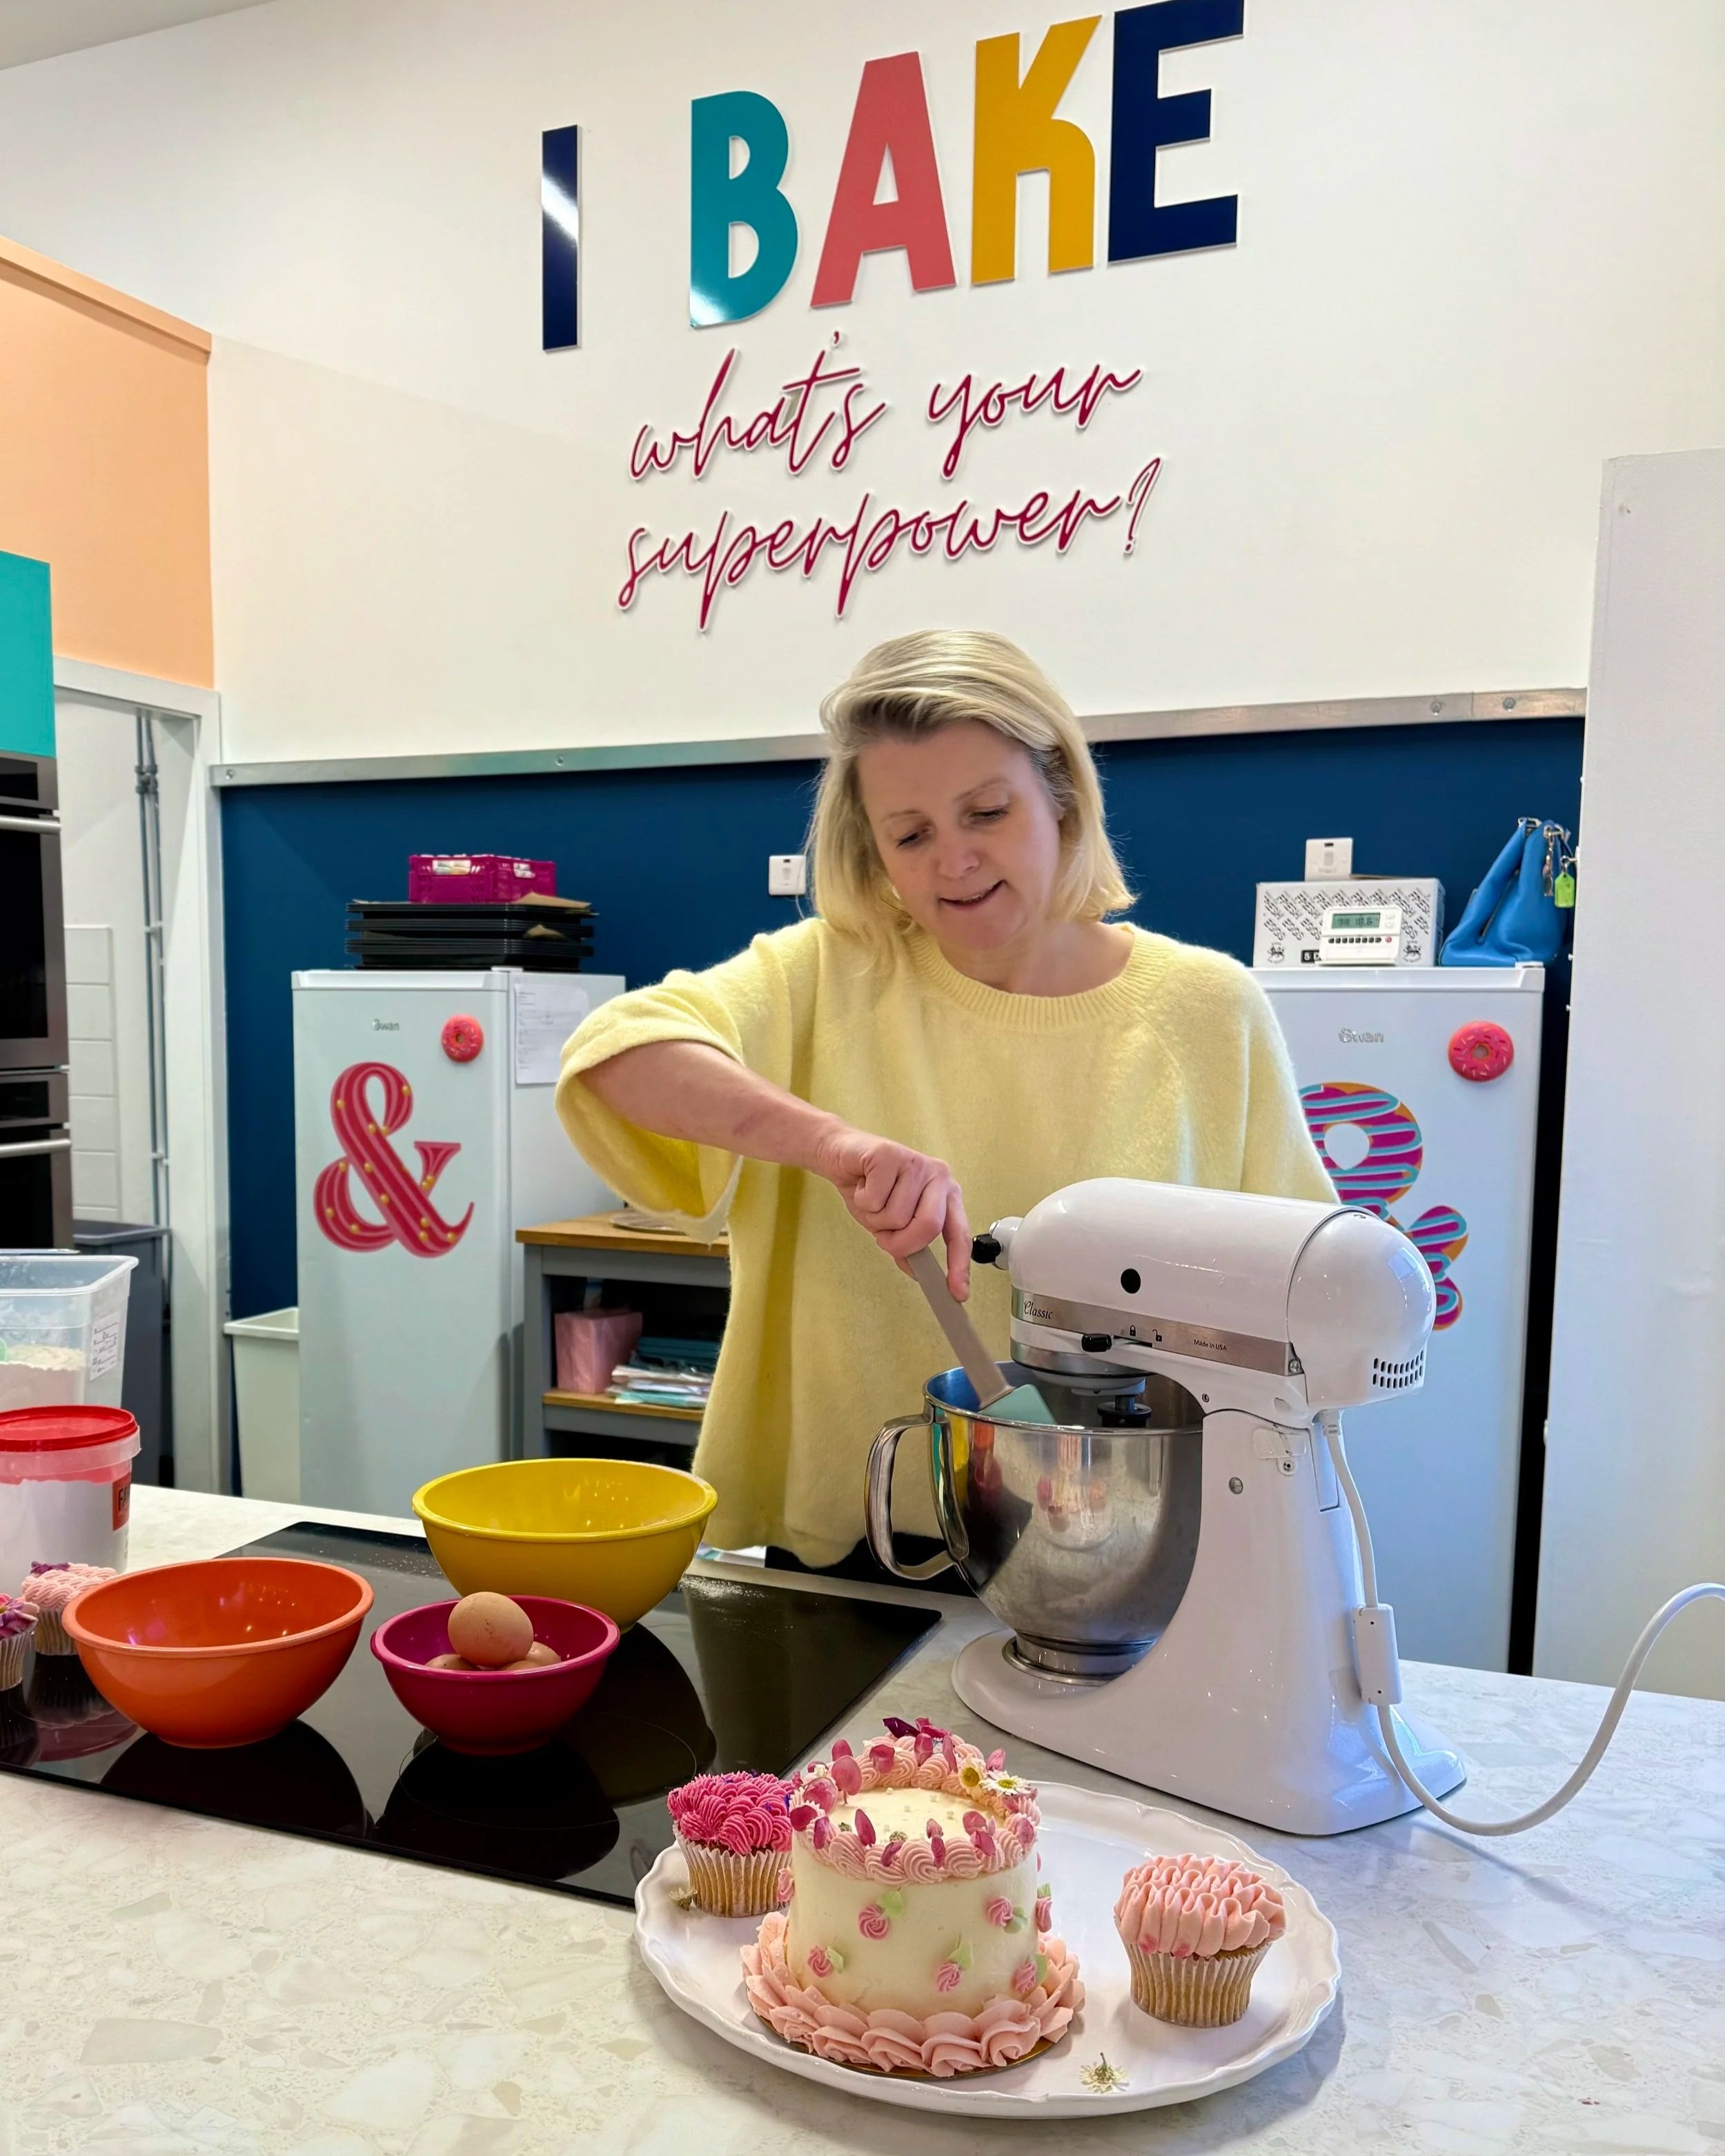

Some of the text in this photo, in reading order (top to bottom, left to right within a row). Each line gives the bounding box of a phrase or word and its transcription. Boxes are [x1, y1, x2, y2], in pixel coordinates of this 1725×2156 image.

[541, 0, 1245, 351] I BAKE
[629, 331, 1143, 481] what's your
[616, 457, 1163, 633] superpower?
[373, 1018, 400, 1031] Swan
[1024, 1300, 1053, 1320] Classic
[1194, 1339, 1208, 1348] Made
